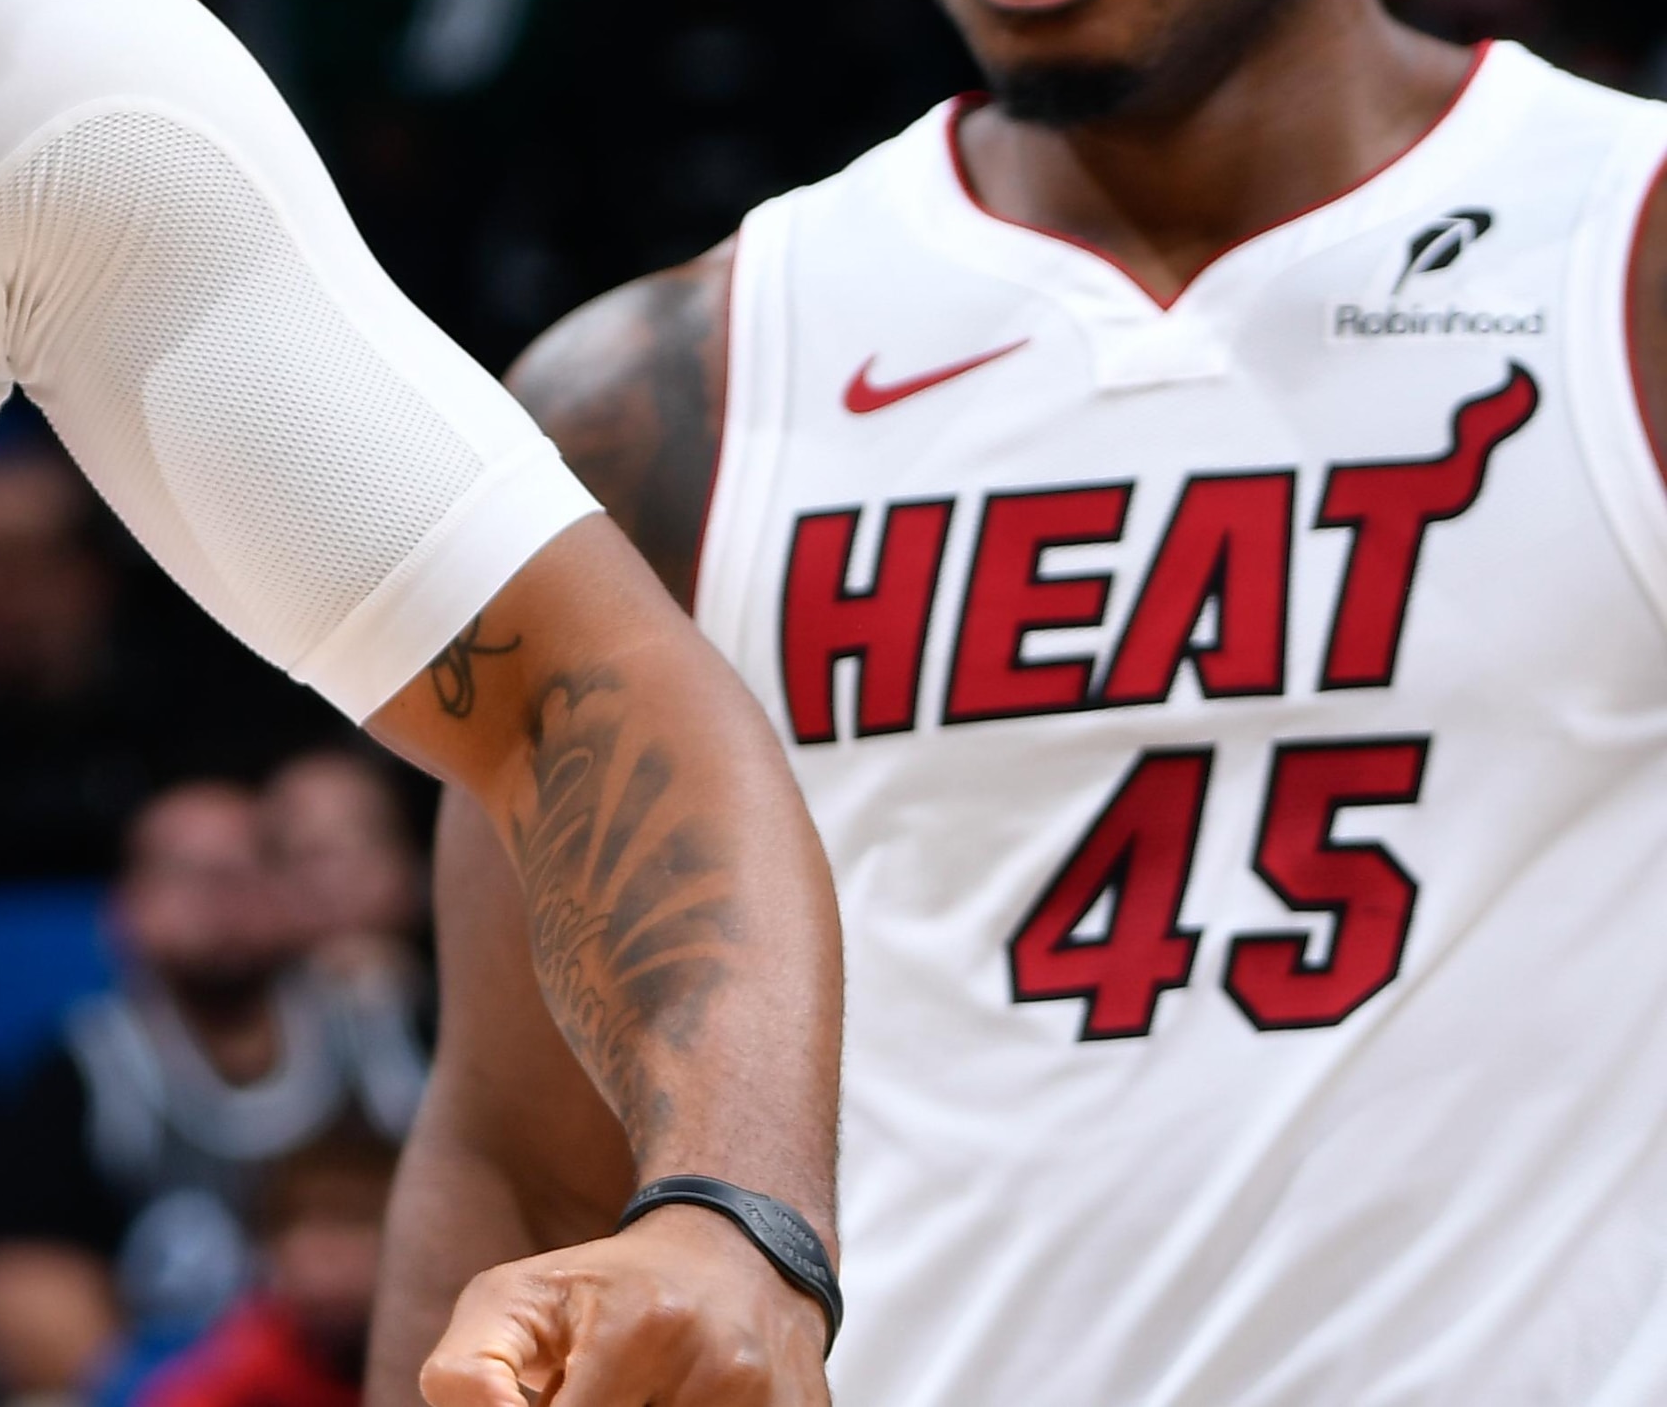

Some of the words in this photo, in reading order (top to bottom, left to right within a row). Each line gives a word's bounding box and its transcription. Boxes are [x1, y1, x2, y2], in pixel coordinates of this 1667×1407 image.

[1335, 304, 1546, 335] Robinhood
[779, 358, 1540, 745] HEAT
[1008, 732, 1433, 1042] 45
